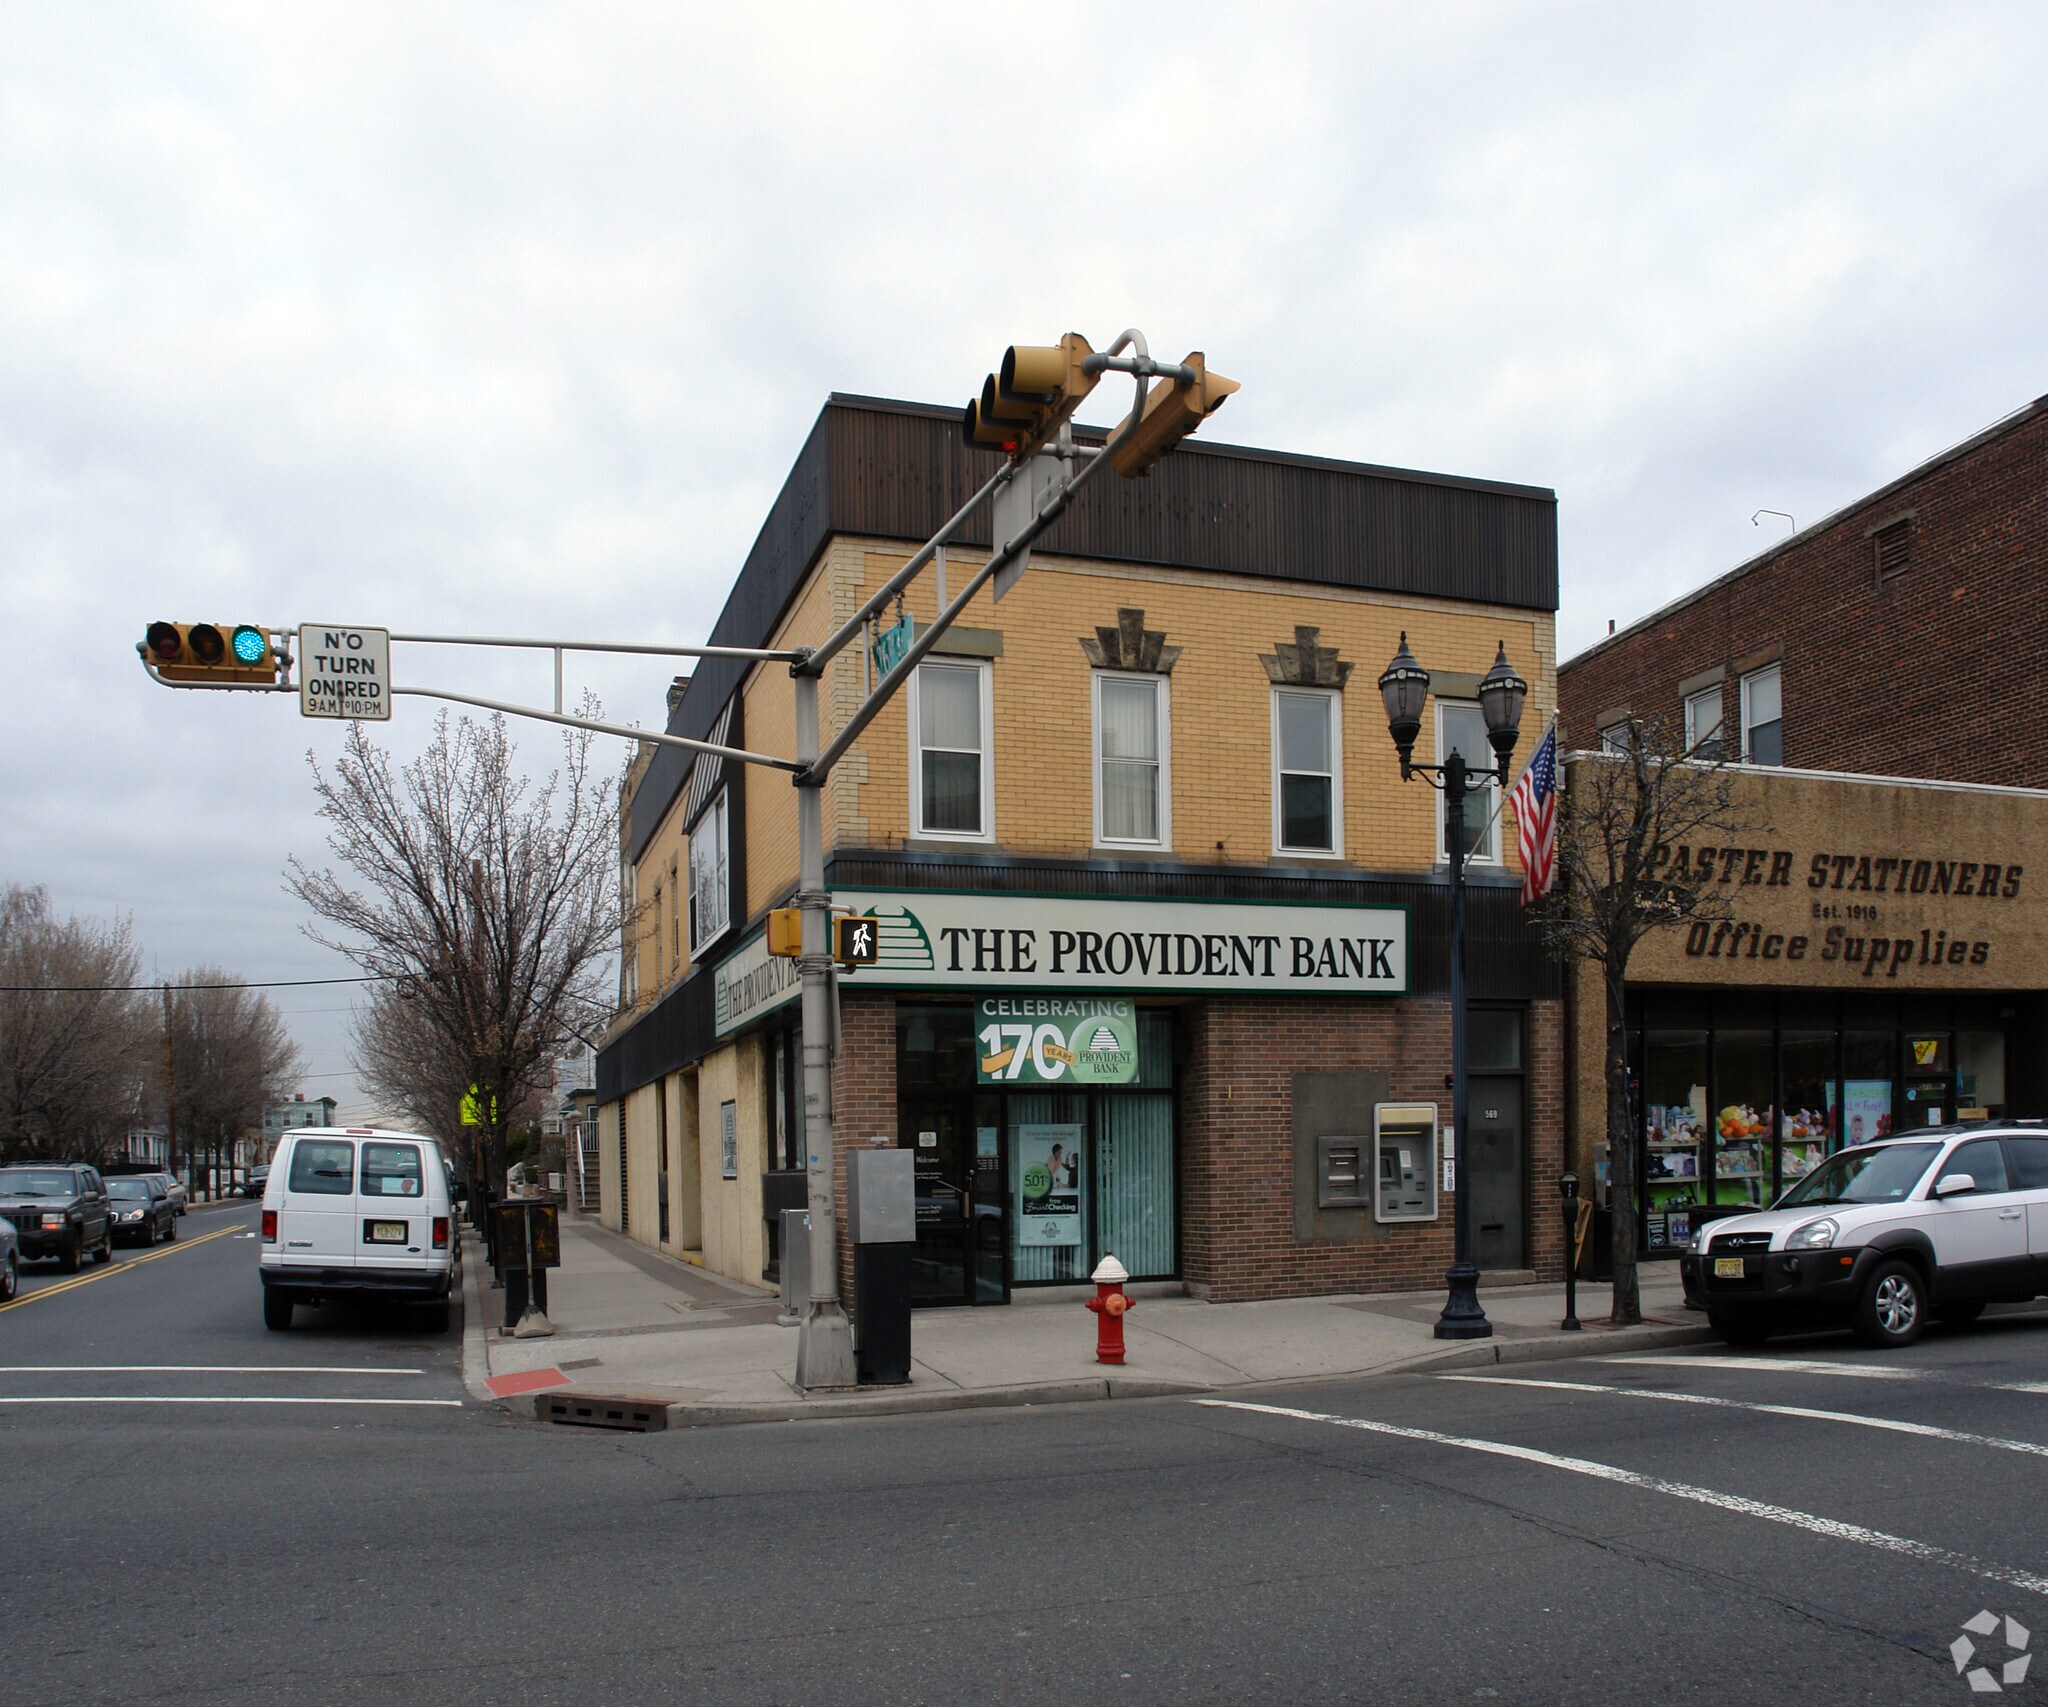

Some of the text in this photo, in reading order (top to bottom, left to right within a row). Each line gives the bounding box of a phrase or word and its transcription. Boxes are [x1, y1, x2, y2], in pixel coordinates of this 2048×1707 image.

[325, 633, 363, 650] NO
[314, 655, 375, 675] TURN
[309, 679, 381, 698] ON RED
[1643, 845, 2023, 897] PASTER STATIONERS
[1812, 902, 1841, 918] Est.
[940, 928, 1395, 978] THE PROVIDENT BANK
[1686, 921, 1990, 977] Office Supplies
[728, 980, 742, 1019] THE
[982, 999, 1128, 1017] CELEBRATING
[978, 1023, 1067, 1080] 170
[1046, 1047, 1073, 1062] YEARS
[1080, 1052, 1132, 1062] PROVIDENT
[1093, 1064, 1119, 1073] BANK
